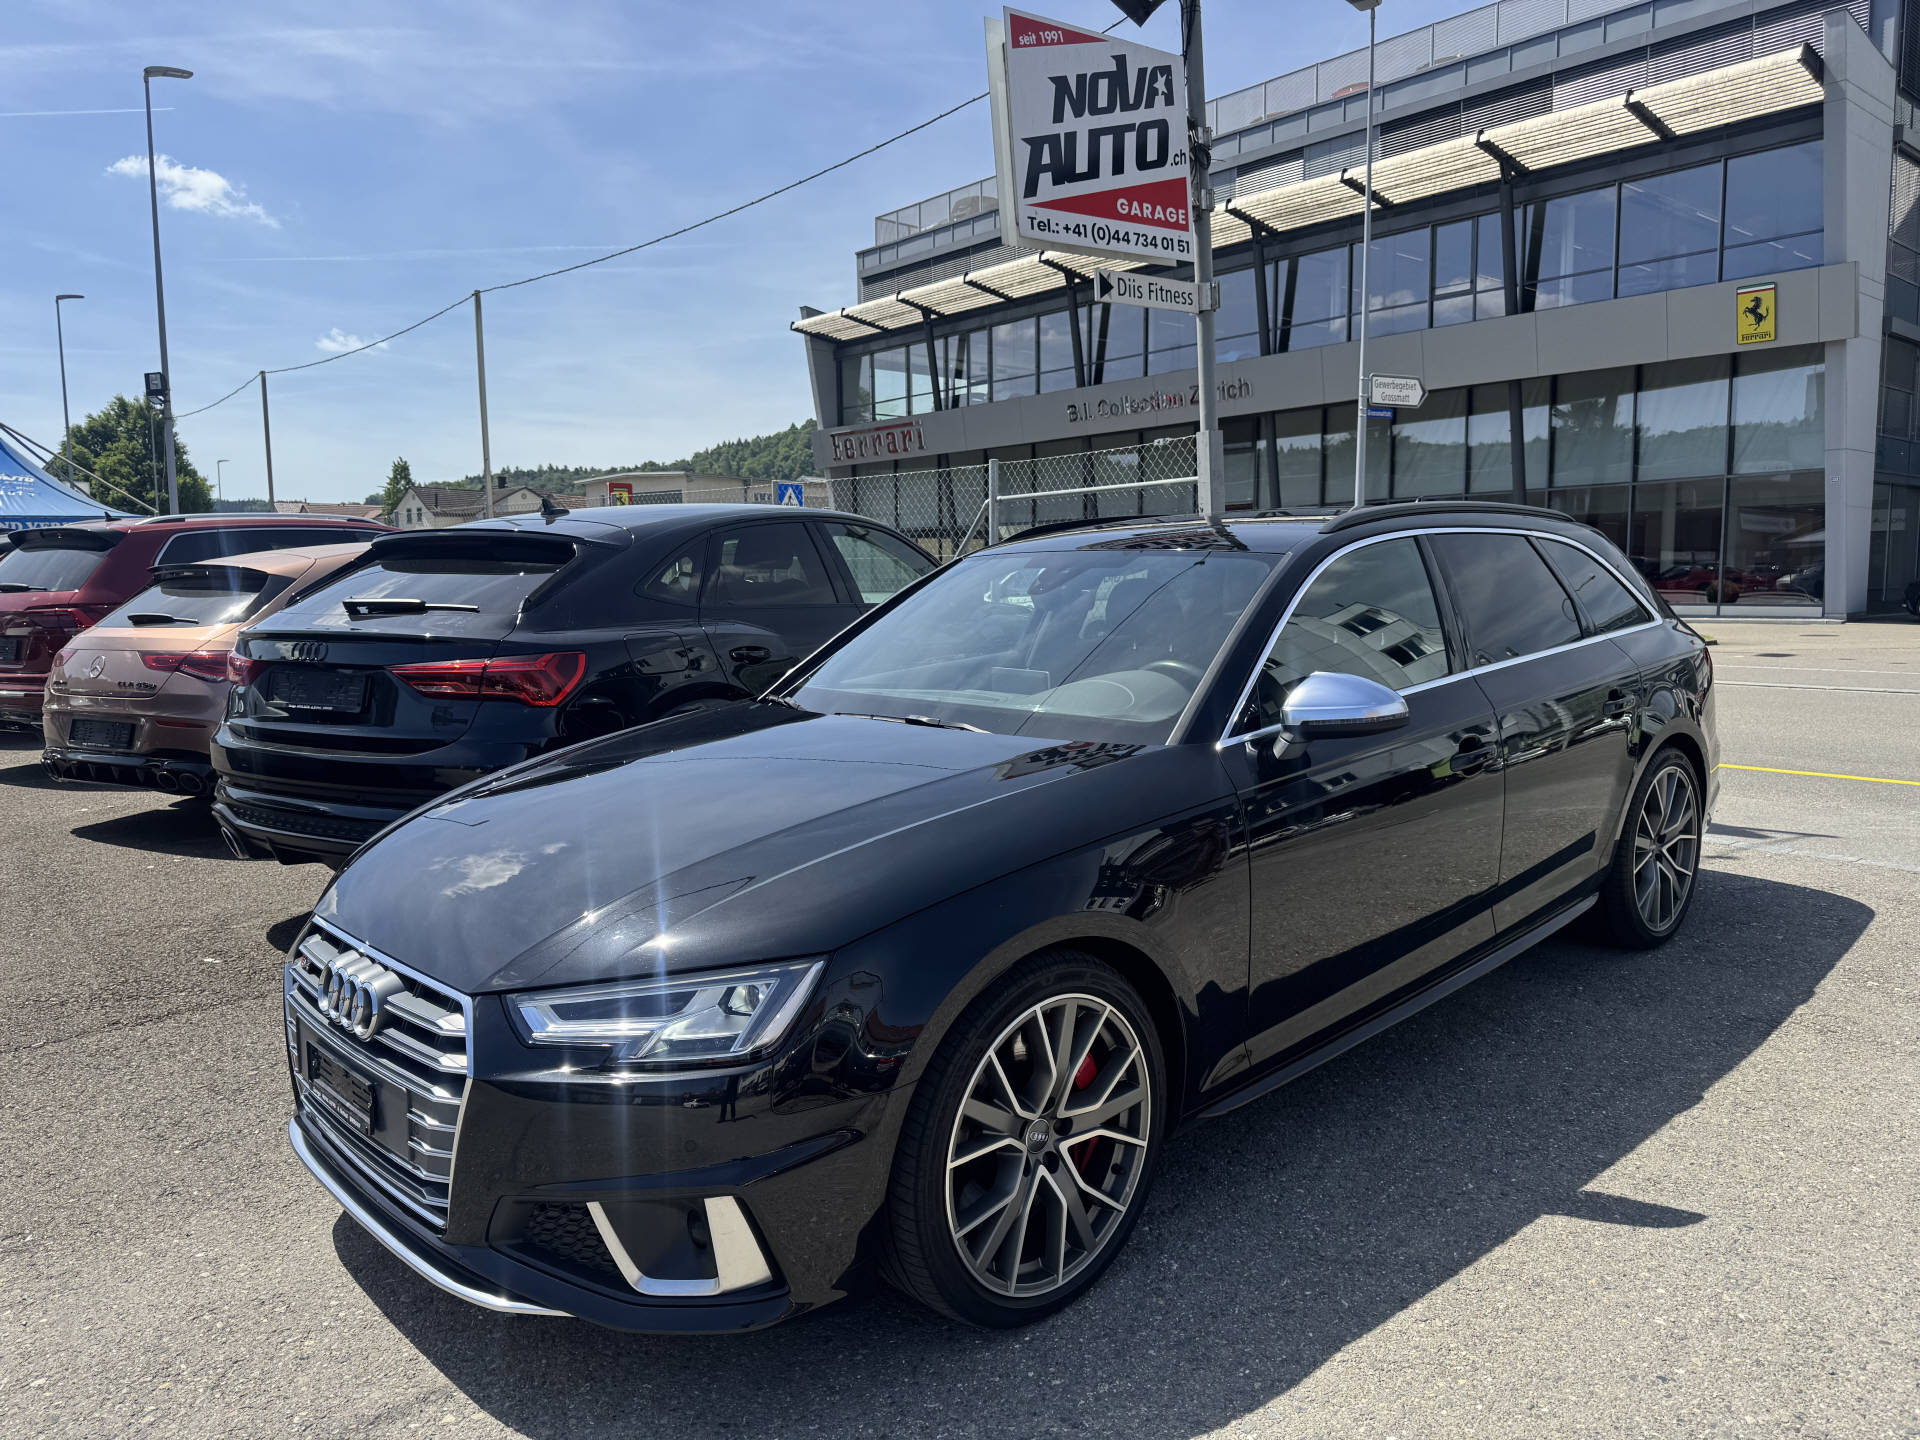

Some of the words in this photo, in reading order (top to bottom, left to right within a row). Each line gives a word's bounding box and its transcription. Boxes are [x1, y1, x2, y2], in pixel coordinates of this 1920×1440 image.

[1019, 32, 1036, 45] seit
[1039, 31, 1064, 44] 1991
[1048, 54, 1175, 124] NOVA
[1117, 198, 1187, 225] GARAGE
[1027, 216, 1060, 234] Tel.:
[1063, 223, 1088, 238] +41
[1133, 232, 1158, 249] 734
[1117, 277, 1143, 298] Diis
[1148, 282, 1194, 306] Fitness
[1741, 331, 1771, 342] Ferrari
[1098, 389, 1186, 418] Collection
[1189, 377, 1253, 406] Zrich
[1375, 379, 1417, 392] Gewerbegebiet
[830, 418, 926, 463] Ferrari
